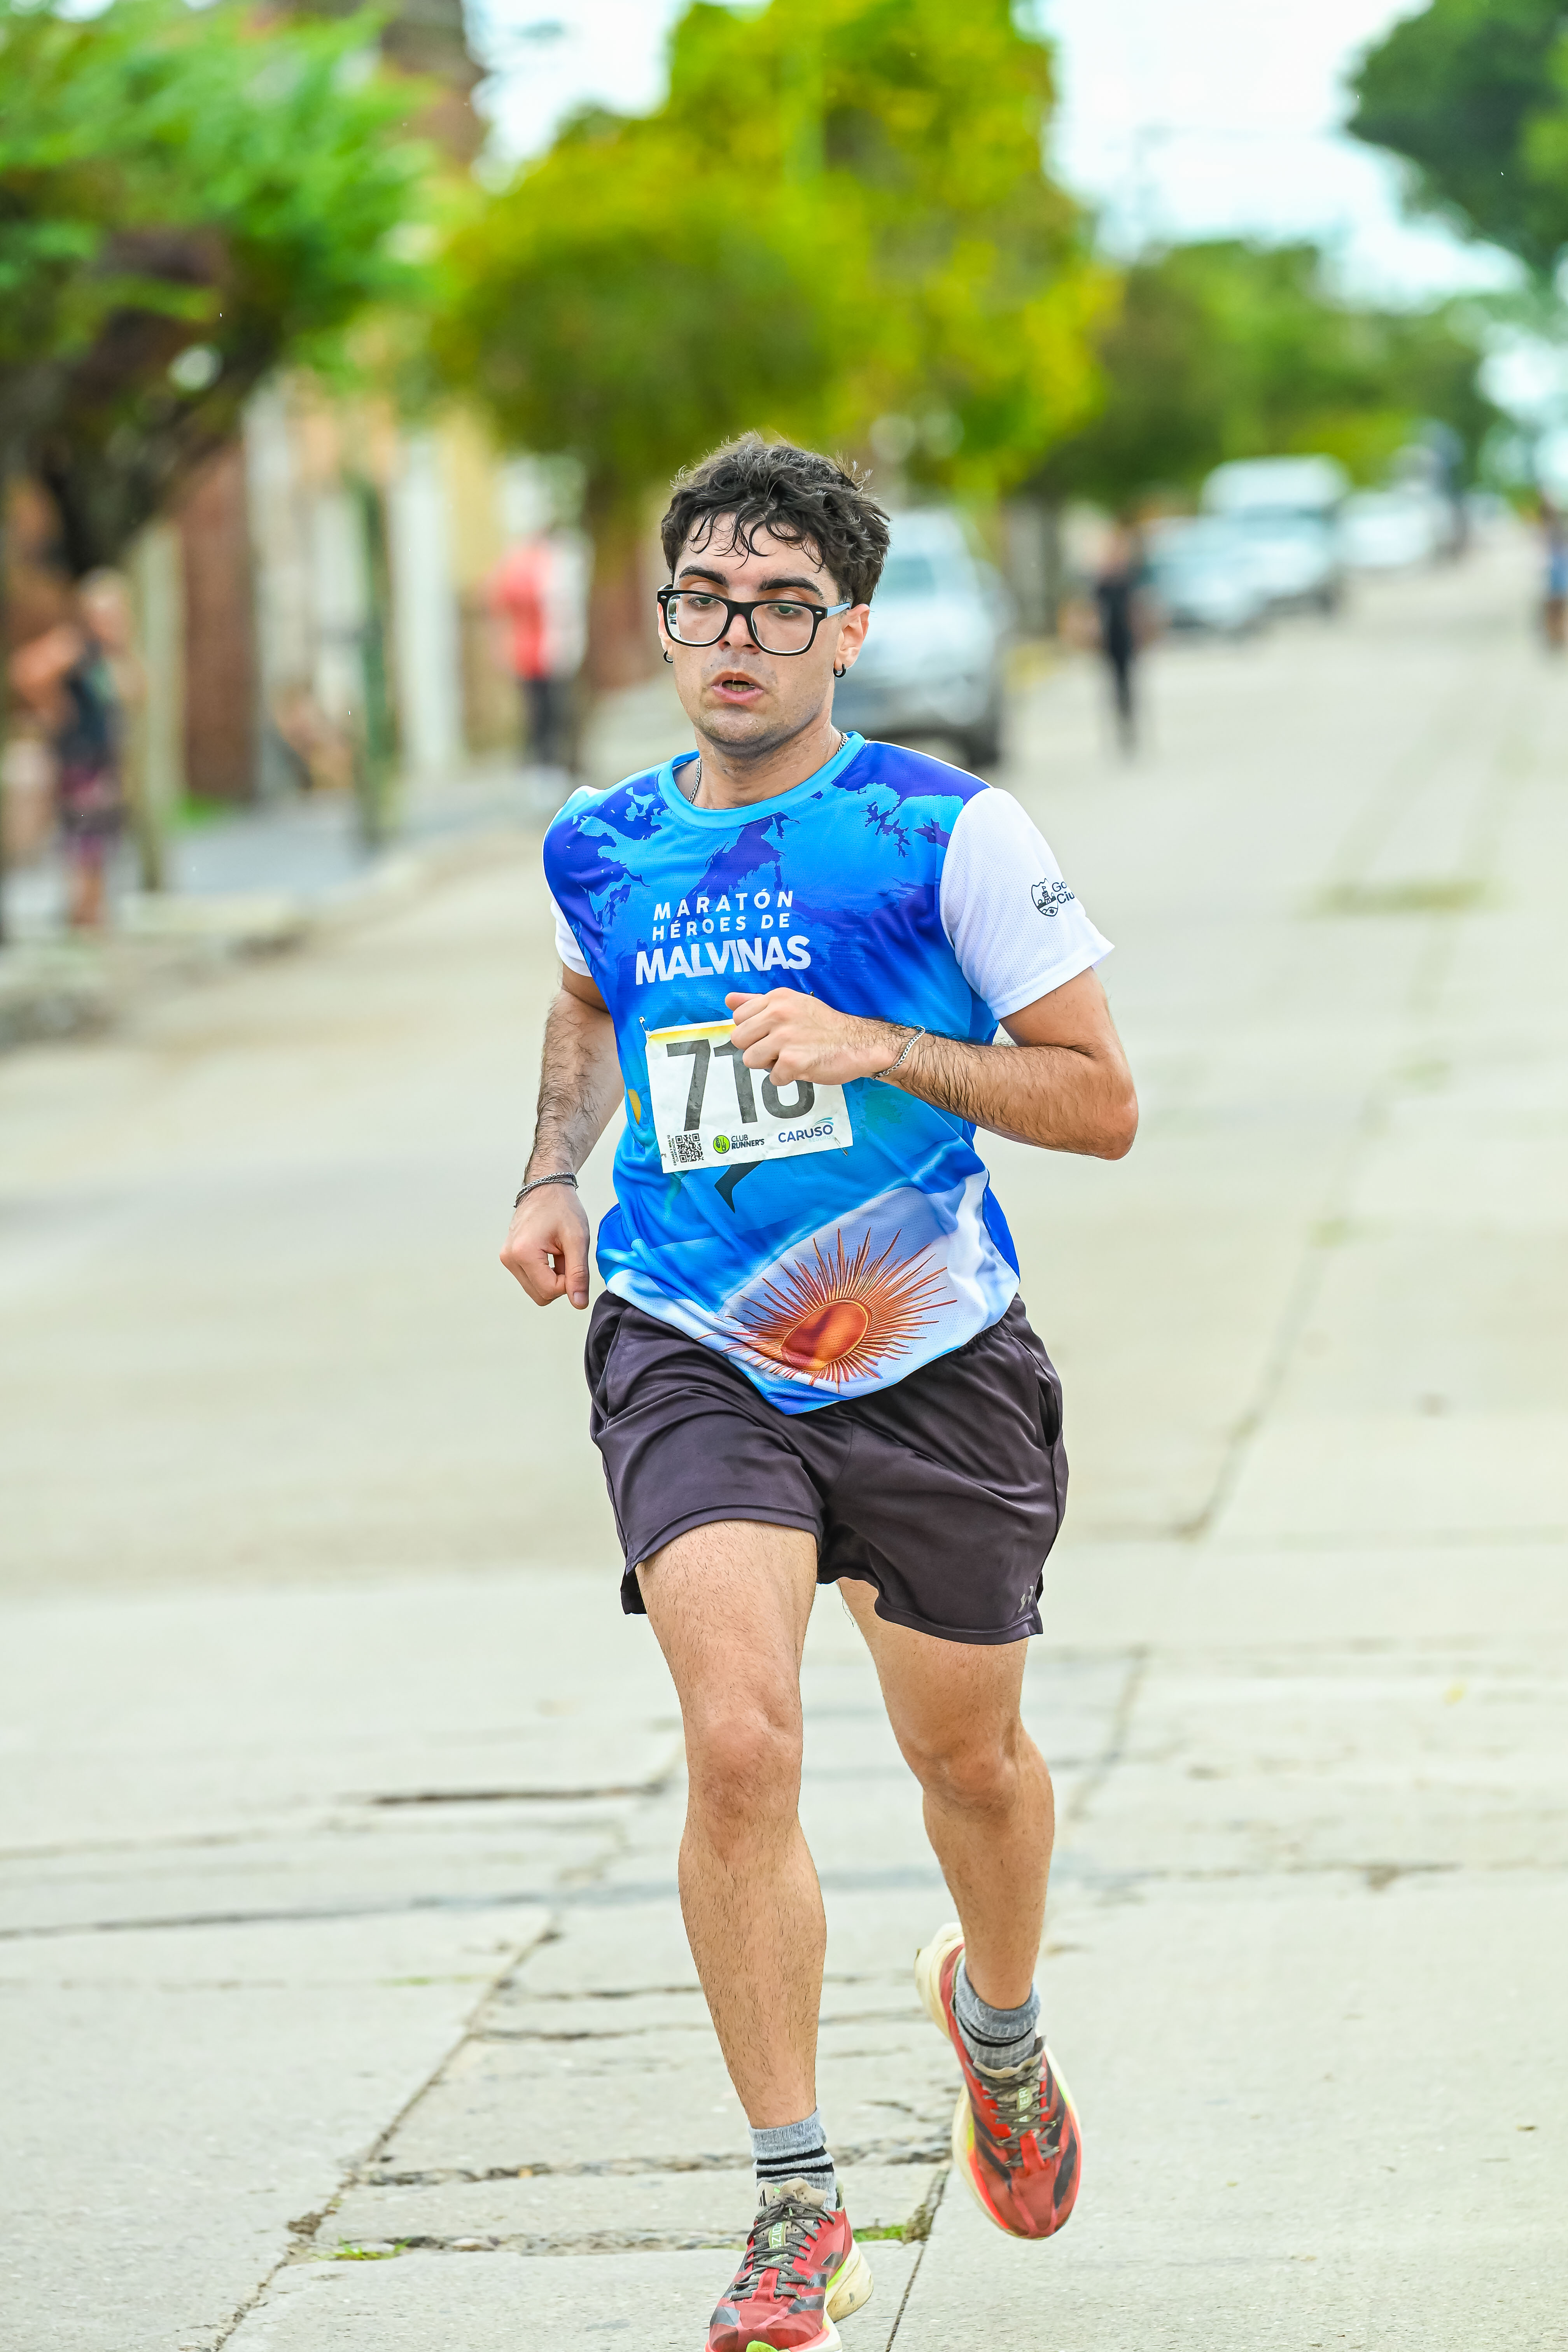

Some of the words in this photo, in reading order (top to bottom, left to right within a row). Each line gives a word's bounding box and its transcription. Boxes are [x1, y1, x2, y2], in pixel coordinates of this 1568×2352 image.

[653, 888, 793, 921] MARATÓN
[652, 915, 746, 941] HÉROES
[761, 913, 790, 929] DE
[635, 935, 811, 985] MALVINAS
[732, 1139, 765, 1150] RUNNER'S
[778, 1125, 833, 1143] CARUSO
